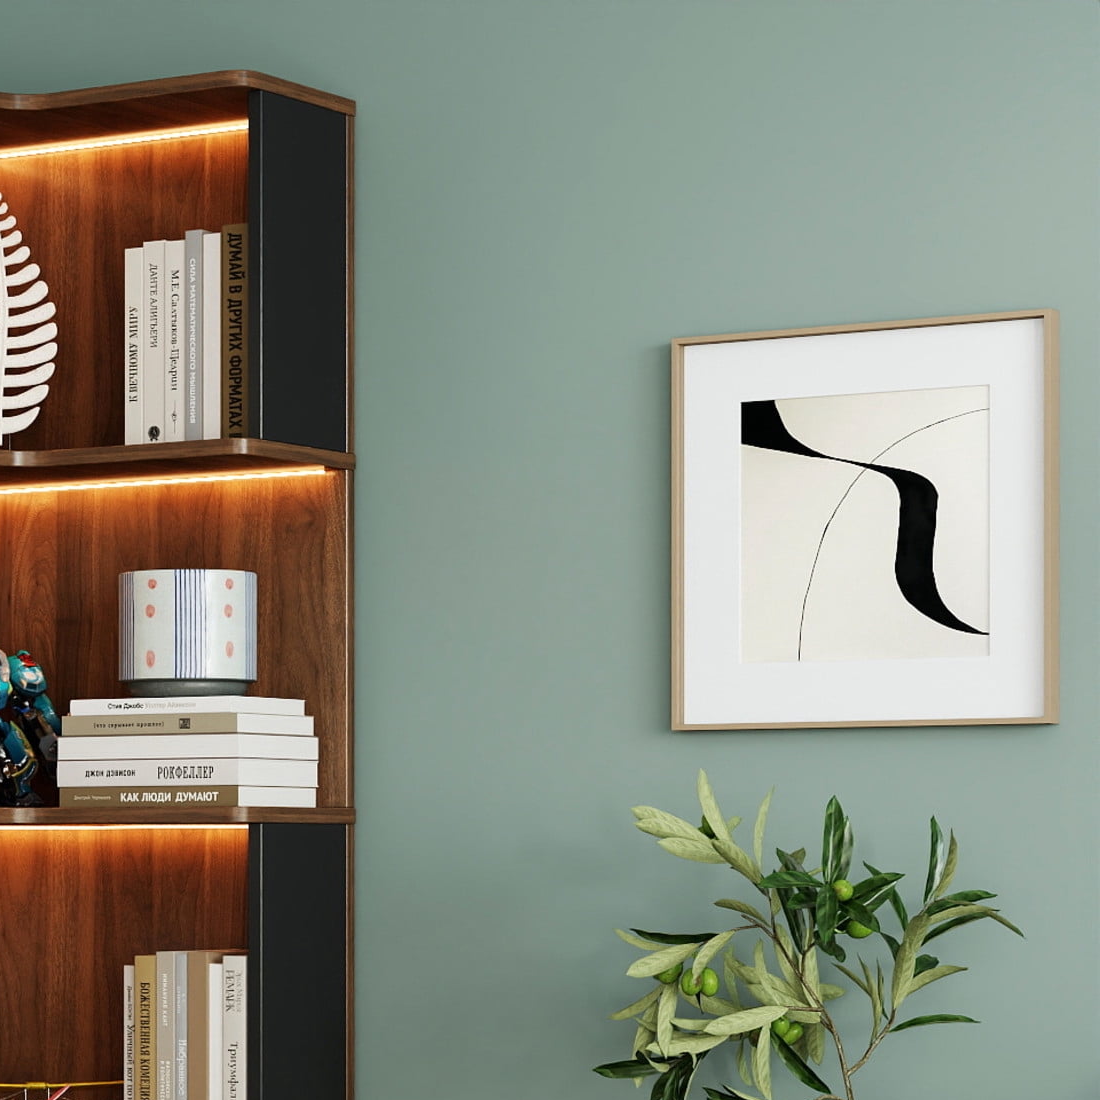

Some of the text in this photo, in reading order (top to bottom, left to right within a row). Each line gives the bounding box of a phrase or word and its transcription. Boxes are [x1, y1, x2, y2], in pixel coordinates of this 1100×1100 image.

[228, 233, 245, 280] ДУМАЙ
[129, 306, 137, 338] МИРУ
[149, 264, 158, 348] ДАНТЕ АЛИГЬЕРИ
[168, 270, 179, 390] М.Е. Салтыков-Щедрин
[227, 299, 242, 350] ДРУГИХ
[129, 343, 137, 392] ВЕЧНОМУ
[229, 356, 242, 428] ФОРМАТАХ
[157, 766, 214, 779] РОКФЕЛЛЕР
[120, 791, 218, 803] КАК ЛЮДИ ДУМАЮТ
[140, 982, 150, 1055] БОЖЕСТВЕННАЯ
[126, 1025, 135, 1064] Уличный
[127, 1085, 134, 1096] по
